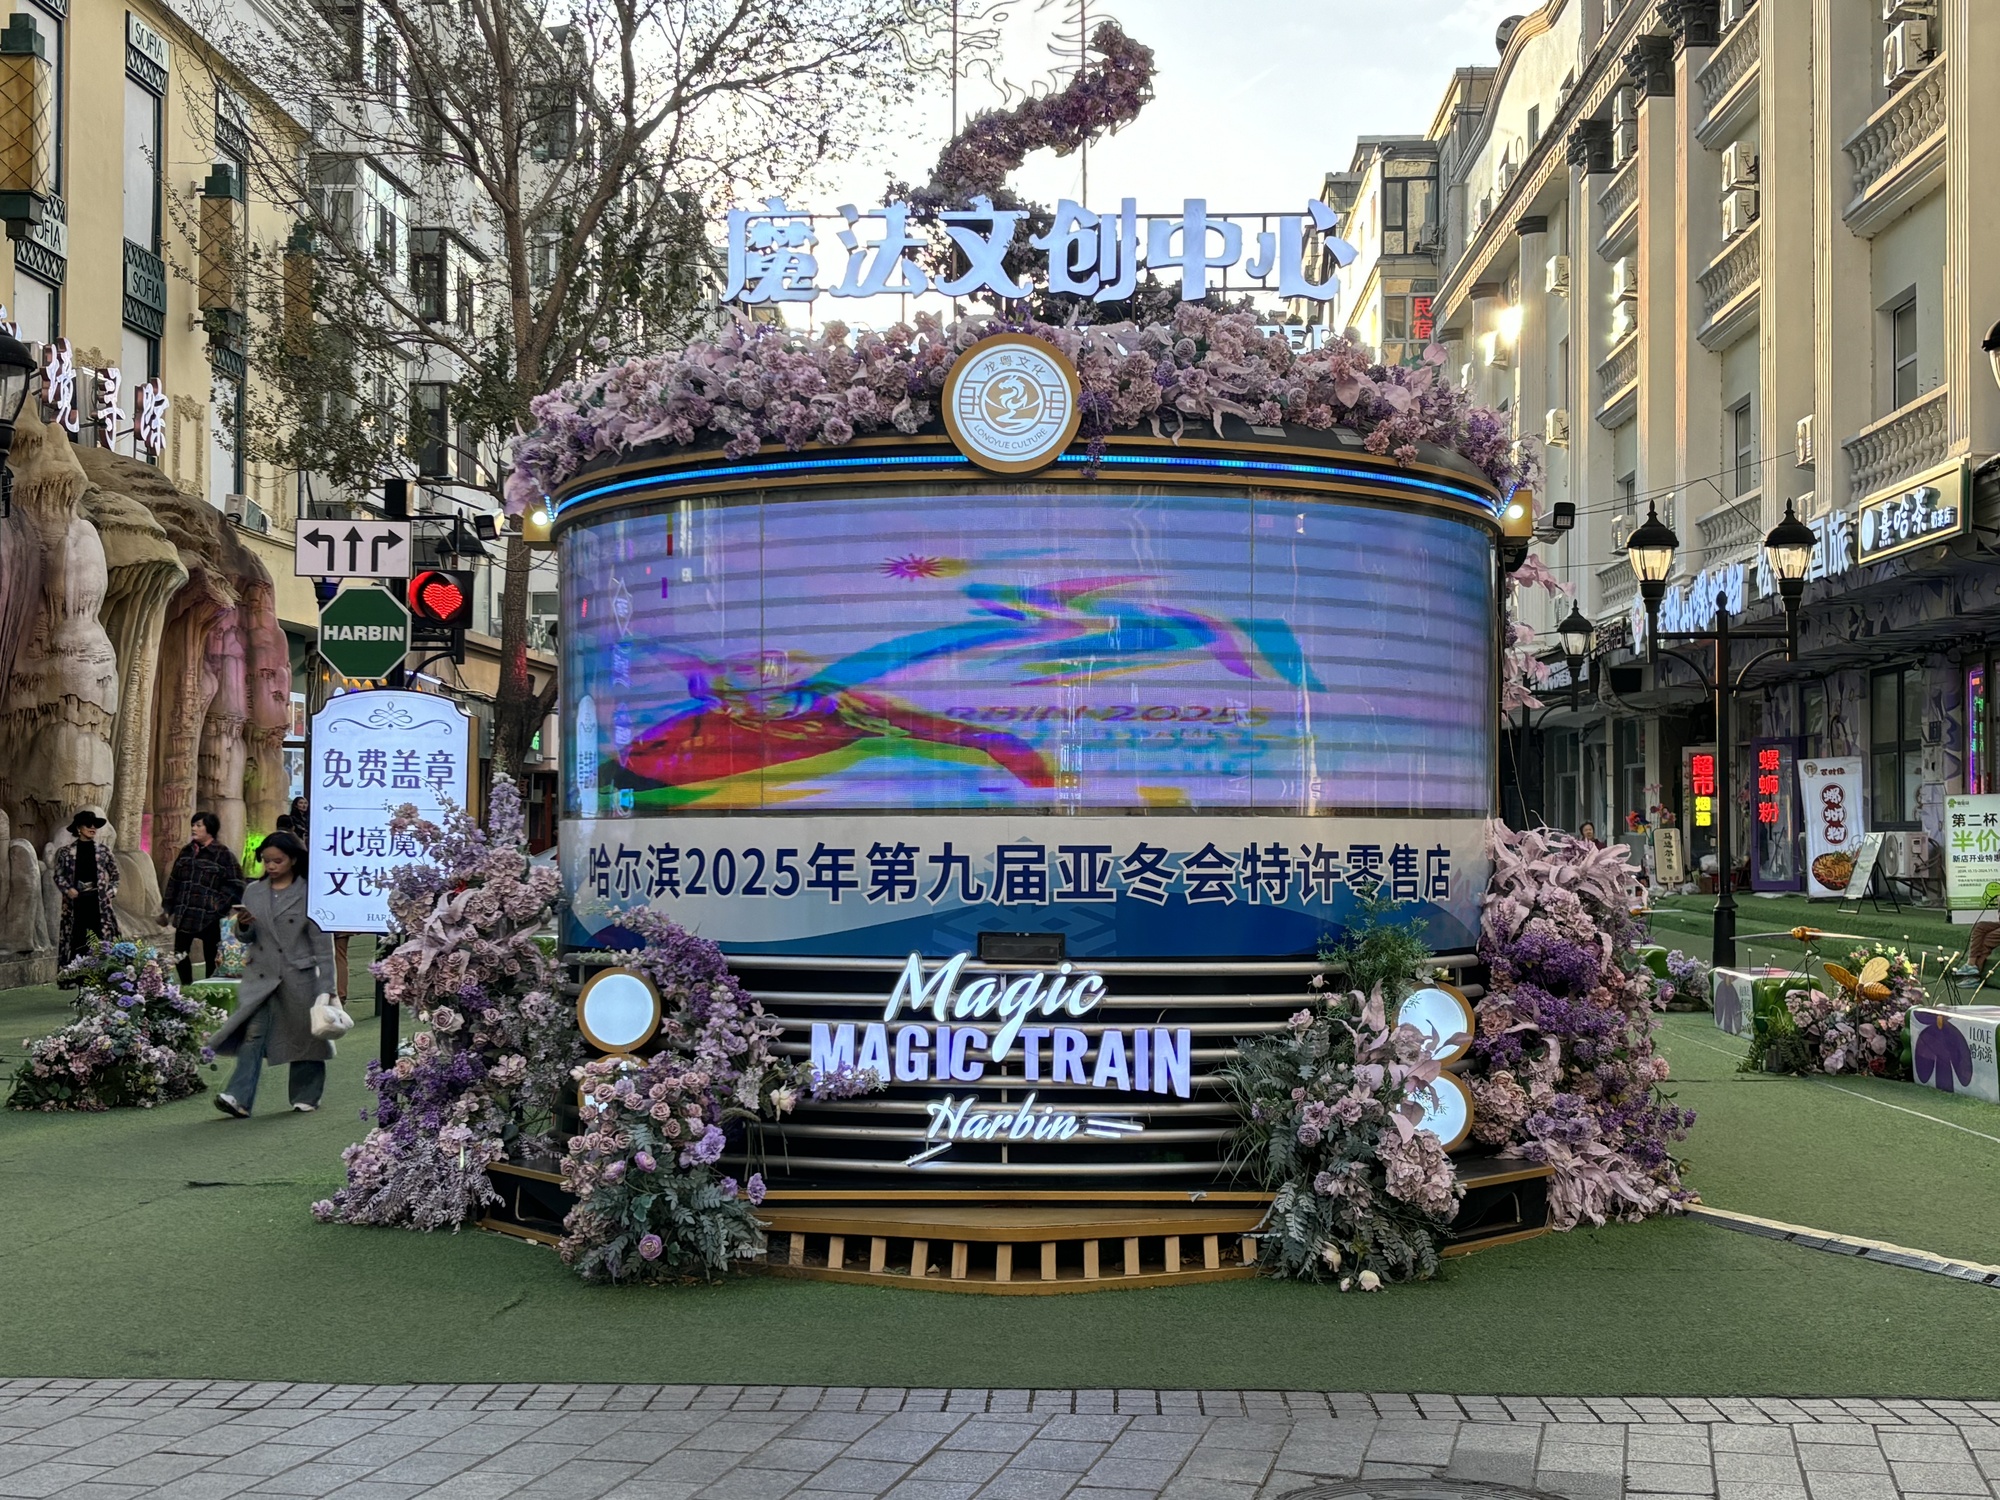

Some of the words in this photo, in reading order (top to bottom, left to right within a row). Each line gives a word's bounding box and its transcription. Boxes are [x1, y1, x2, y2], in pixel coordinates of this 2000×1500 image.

[135, 22, 164, 64] SOFIA
[34, 218, 62, 252] OFIA
[722, 195, 1359, 302] 魔法文创中心
[132, 271, 162, 308] SOFIA
[1413, 297, 1433, 339] 民宿
[0, 303, 170, 457] 境寻踪
[983, 355, 1046, 378] 龙粤文化
[974, 424, 1010, 449] LONGYUE
[1011, 427, 1048, 449] CULTURE
[323, 625, 405, 643] HARBIN
[322, 748, 456, 791] 免费盖章
[1692, 754, 1714, 796] 超市
[1758, 749, 1780, 823] 螺蛳粉
[1951, 812, 1998, 828] 第二杯
[1951, 828, 2000, 853] 半价
[320, 826, 436, 858] 北境魔
[588, 840, 1452, 904] 哈尔滨2025年第九届亚冬会特许零售店
[883, 950, 1107, 1063] Magic
[810, 1022, 989, 1094] MAGIC
[1019, 1028, 1192, 1099] TRAIN
[1969, 1043, 1993, 1064] 哈尔滨
[926, 1090, 1081, 1142] Harbin
